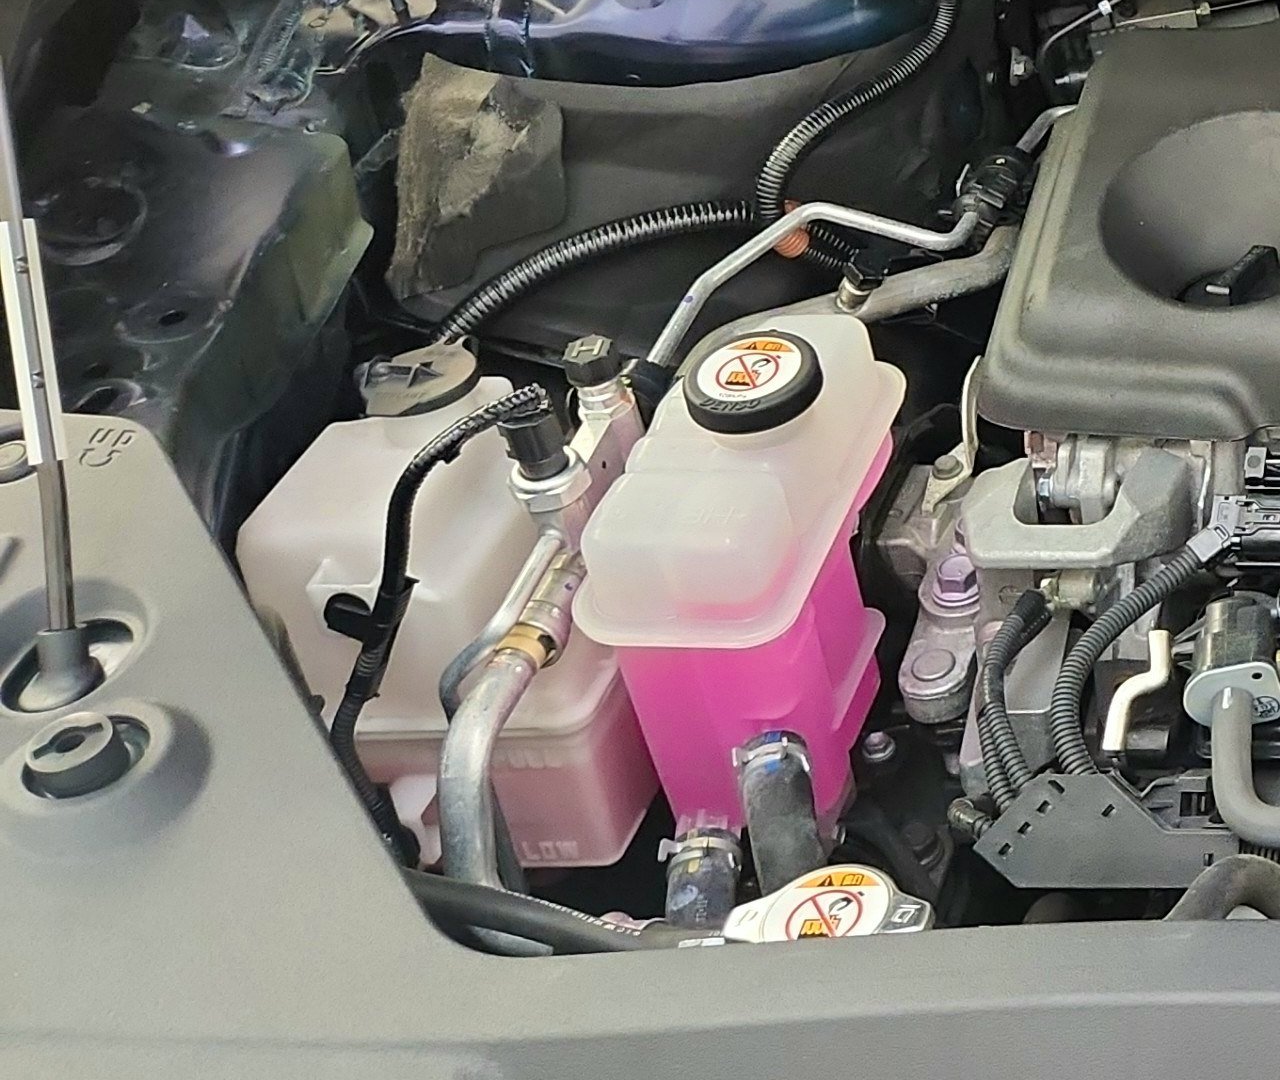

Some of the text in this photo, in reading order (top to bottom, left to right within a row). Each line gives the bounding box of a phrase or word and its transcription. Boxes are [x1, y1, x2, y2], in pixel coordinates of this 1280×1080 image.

[571, 338, 604, 358] H
[699, 397, 761, 413] DENSO
[88, 427, 137, 448] UP
[520, 840, 578, 861] LOW
